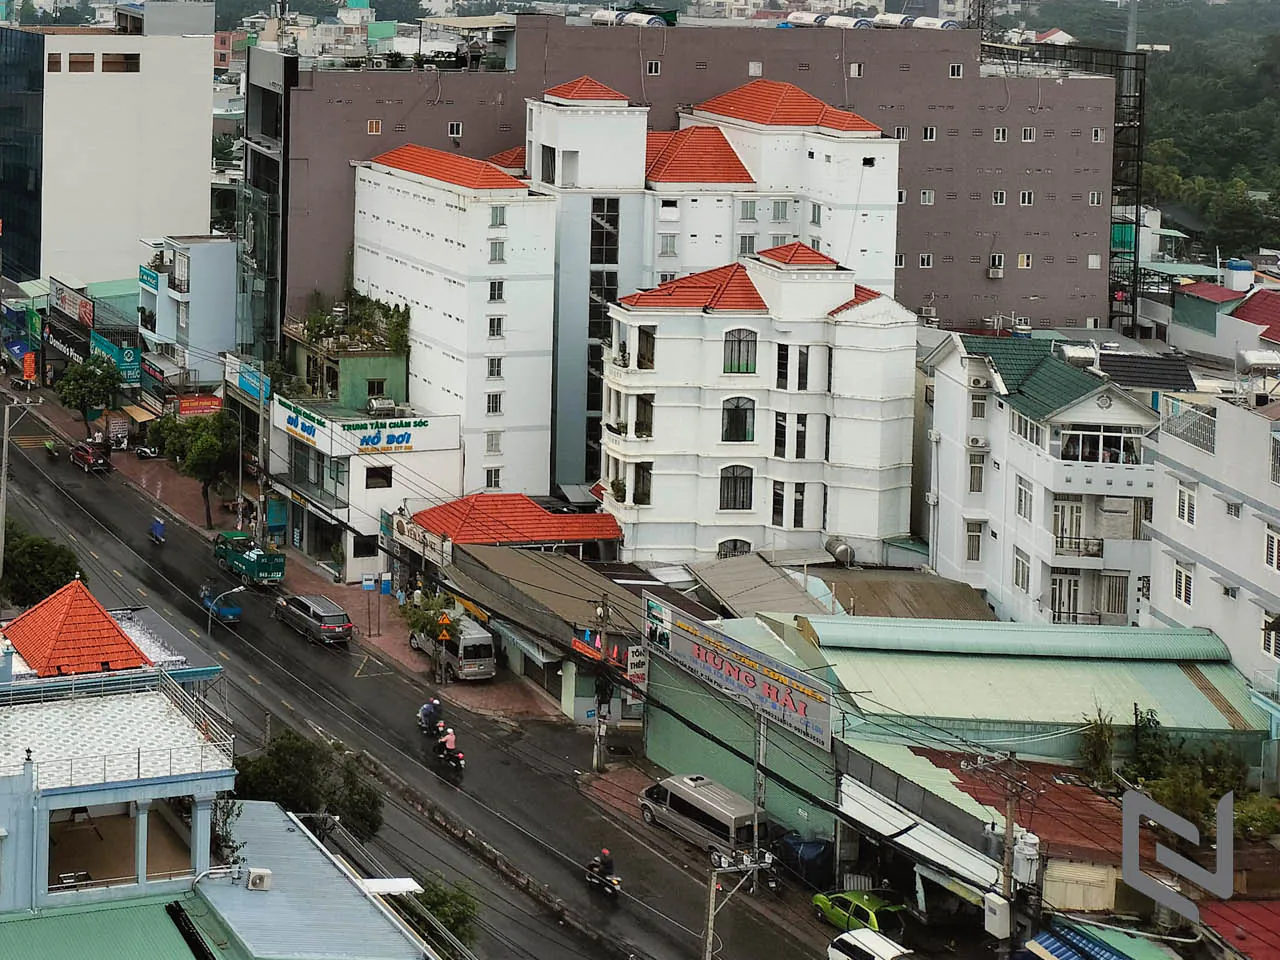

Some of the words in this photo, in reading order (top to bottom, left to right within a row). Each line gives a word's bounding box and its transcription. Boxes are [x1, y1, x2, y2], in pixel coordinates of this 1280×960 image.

[49, 334, 70, 356] Domino's
[70, 347, 83, 365] Pizza
[342, 423, 368, 431] TRUNG
[369, 420, 387, 429] TÂM
[413, 418, 429, 427] SÓC
[360, 430, 382, 446] HỒ
[386, 431, 412, 444] BƠI
[630, 659, 646, 670] THÉP
[693, 643, 756, 688] HÙNG
[762, 681, 807, 717] HẢI
